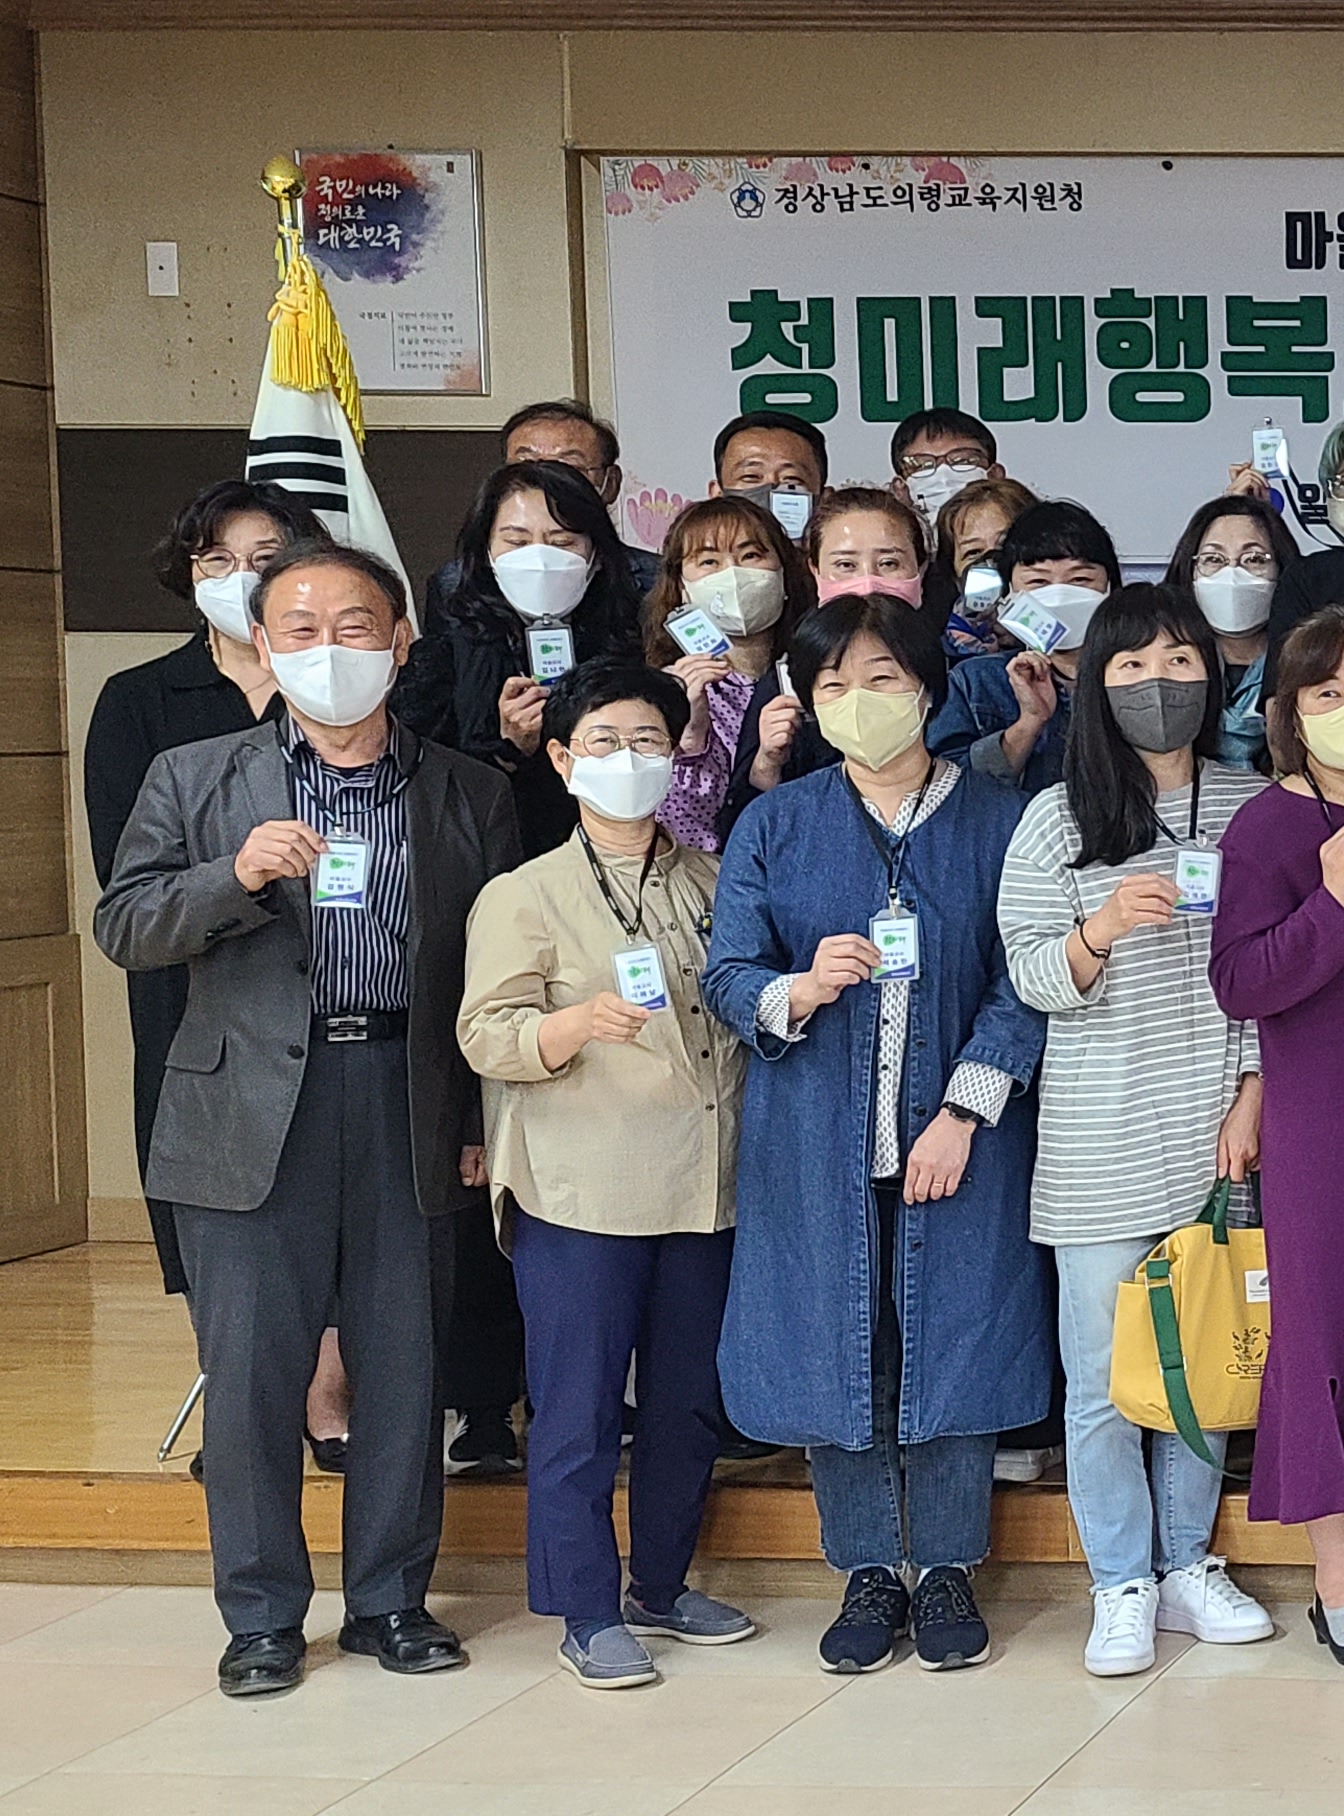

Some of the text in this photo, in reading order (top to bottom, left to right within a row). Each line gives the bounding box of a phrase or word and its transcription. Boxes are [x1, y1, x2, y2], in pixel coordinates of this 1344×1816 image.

[315, 176, 402, 202] 국민의 나라
[774, 182, 1083, 213] 경상남도의령교육지원청
[317, 203, 367, 222] 정의로운
[317, 222, 403, 252] 대한민국
